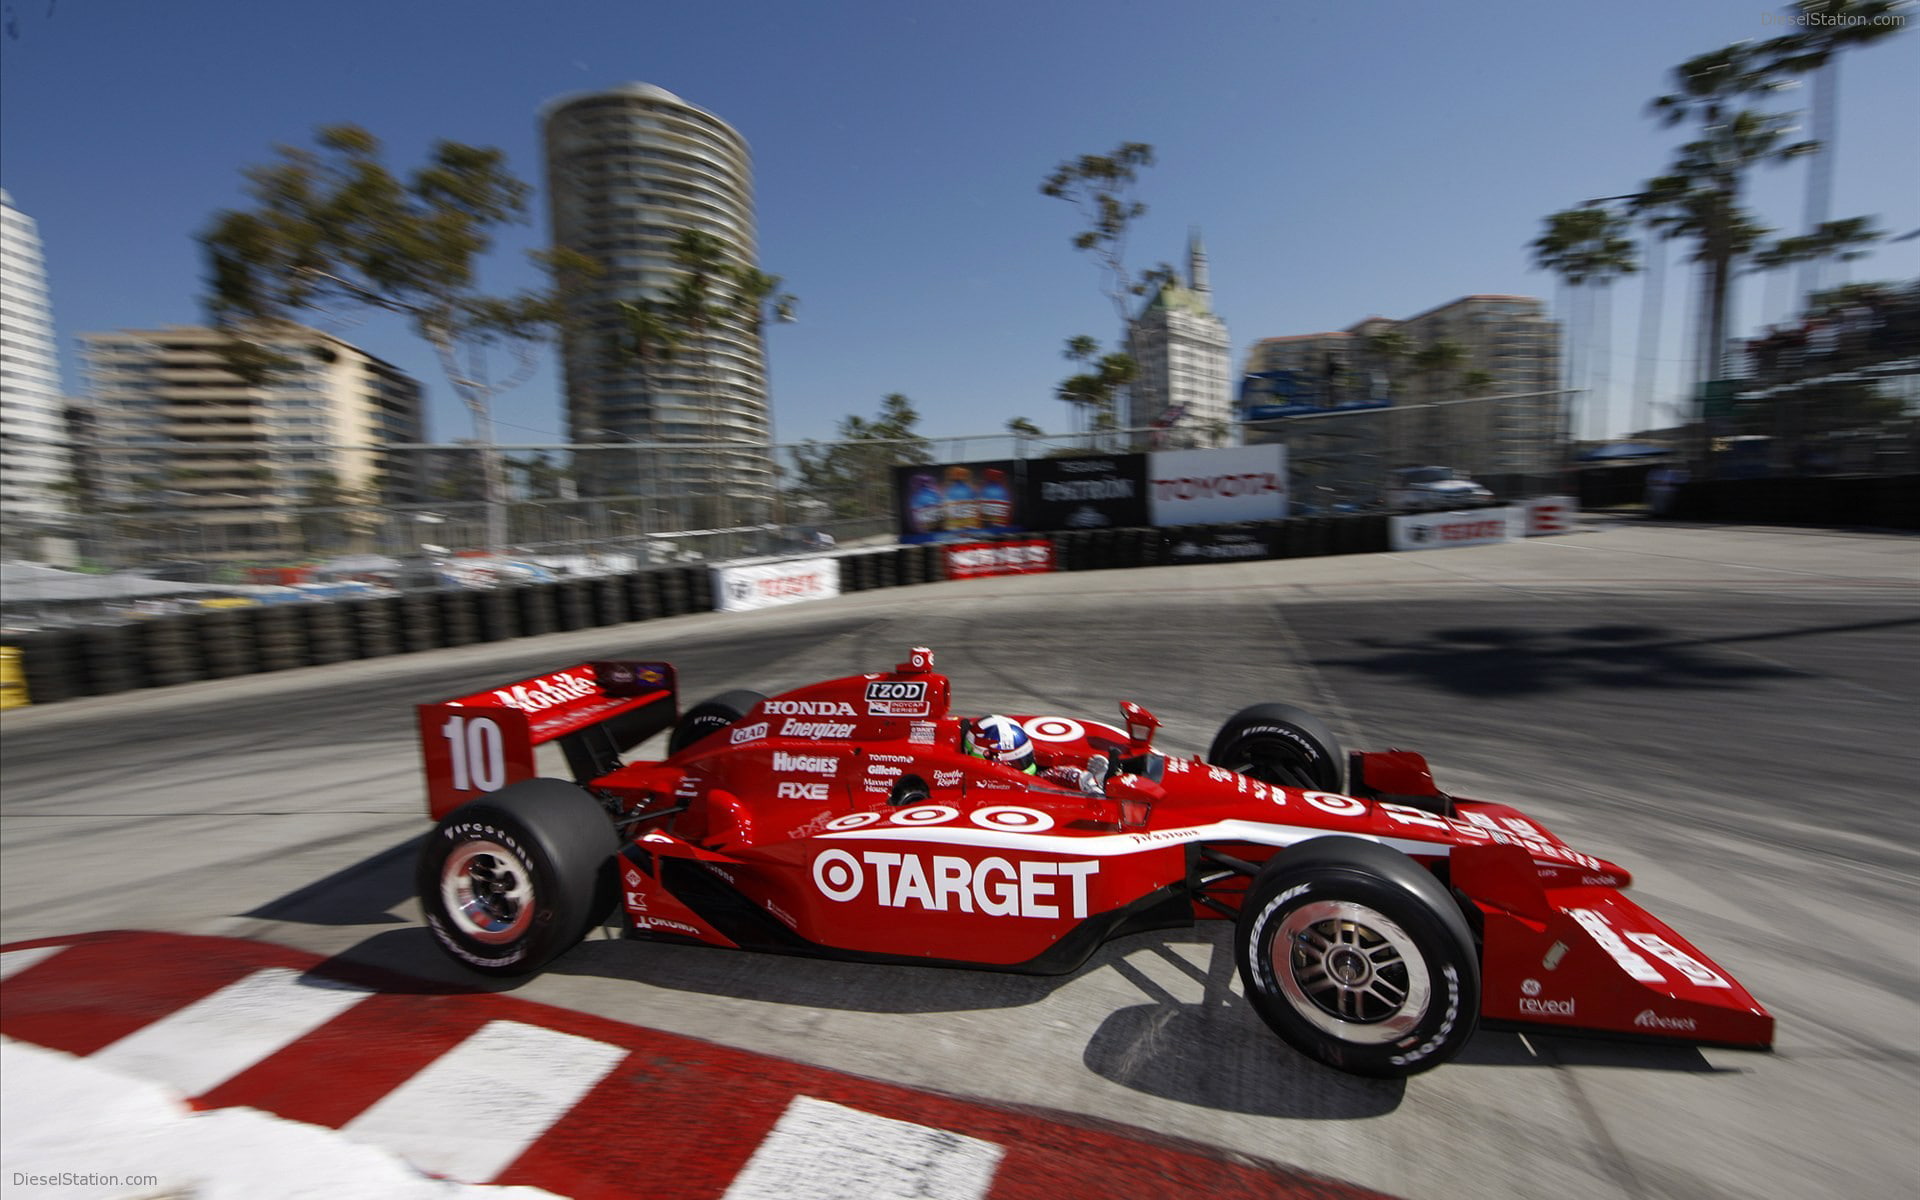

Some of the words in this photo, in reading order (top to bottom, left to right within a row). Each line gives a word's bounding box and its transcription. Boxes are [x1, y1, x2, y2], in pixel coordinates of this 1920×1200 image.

[1149, 472, 1284, 502] TOYOTA
[869, 683, 921, 699] IZOD
[763, 700, 858, 717] HONDA
[733, 726, 766, 742] GLAD
[779, 718, 858, 741] Energizer
[1241, 725, 1320, 760] FIREHAWK
[441, 714, 506, 793] 10
[867, 765, 903, 776] Gillette
[933, 768, 965, 780] Breathe
[863, 778, 894, 788] Maxwell
[865, 785, 889, 795] House
[937, 776, 960, 788] Right
[777, 782, 830, 801] AXE
[1129, 829, 1202, 845] Firestone
[443, 822, 534, 872] Firestone
[863, 851, 1100, 919] TARGET
[1519, 997, 1575, 1015] reveal
